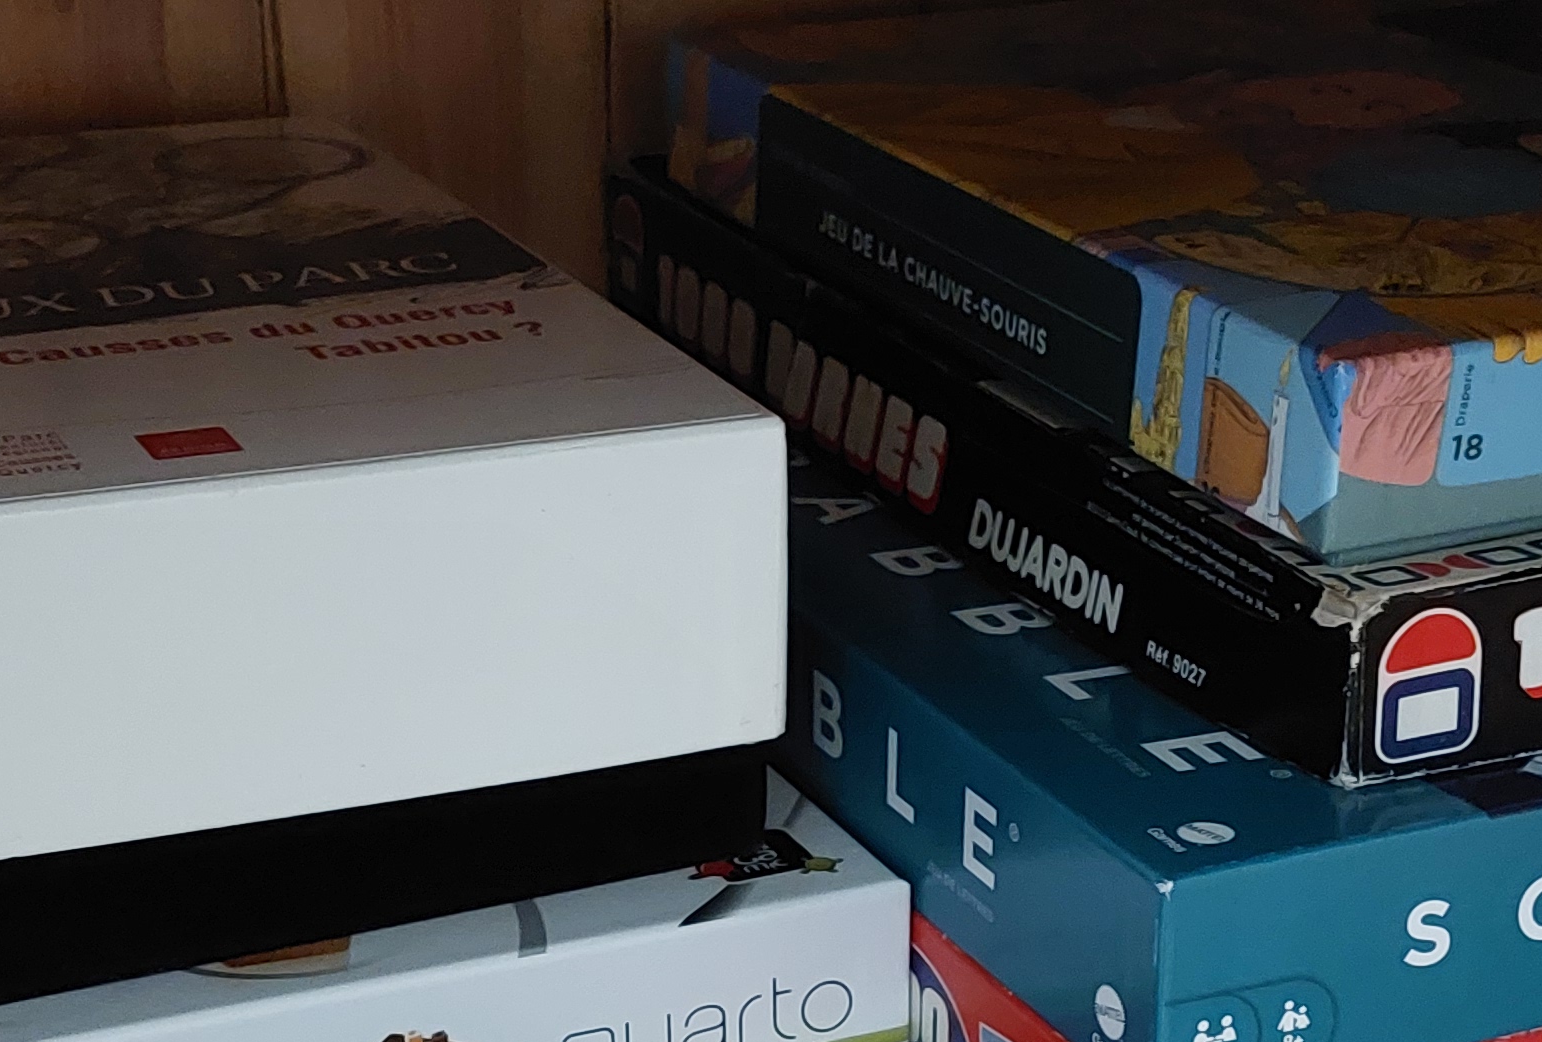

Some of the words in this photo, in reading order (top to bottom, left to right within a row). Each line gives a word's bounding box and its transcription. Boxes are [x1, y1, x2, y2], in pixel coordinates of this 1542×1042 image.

[95, 278, 217, 310] DU
[241, 252, 459, 296] PARC
[819, 211, 847, 243] JEU
[852, 226, 874, 260] DE
[877, 242, 899, 273] LA
[904, 256, 1047, 355] CHAUVE-SOURIS
[250, 317, 316, 340] du
[330, 294, 519, 335] Quercy
[300, 324, 503, 363] Tabitou
[515, 320, 545, 338] ?
[1451, 432, 1484, 462] 18
[967, 499, 1124, 634] DUJARDIN
[1171, 653, 1207, 687] 9027
